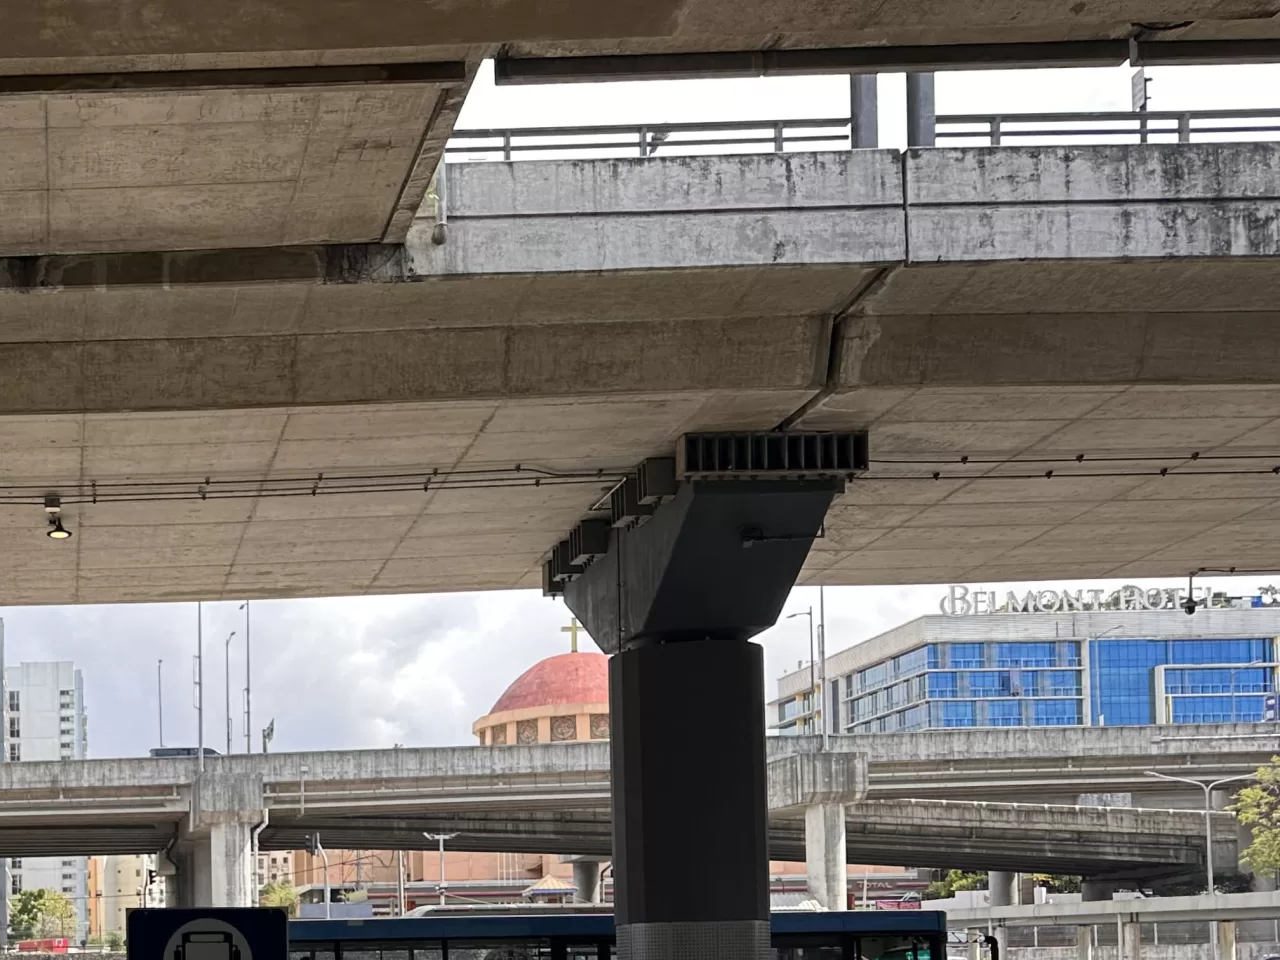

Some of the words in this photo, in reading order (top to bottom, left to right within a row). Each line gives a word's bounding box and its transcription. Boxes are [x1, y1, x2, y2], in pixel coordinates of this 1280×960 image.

[939, 585, 1104, 617] BELMONT
[1119, 585, 1213, 610] HOTEL
[856, 881, 893, 889] TOTAL
